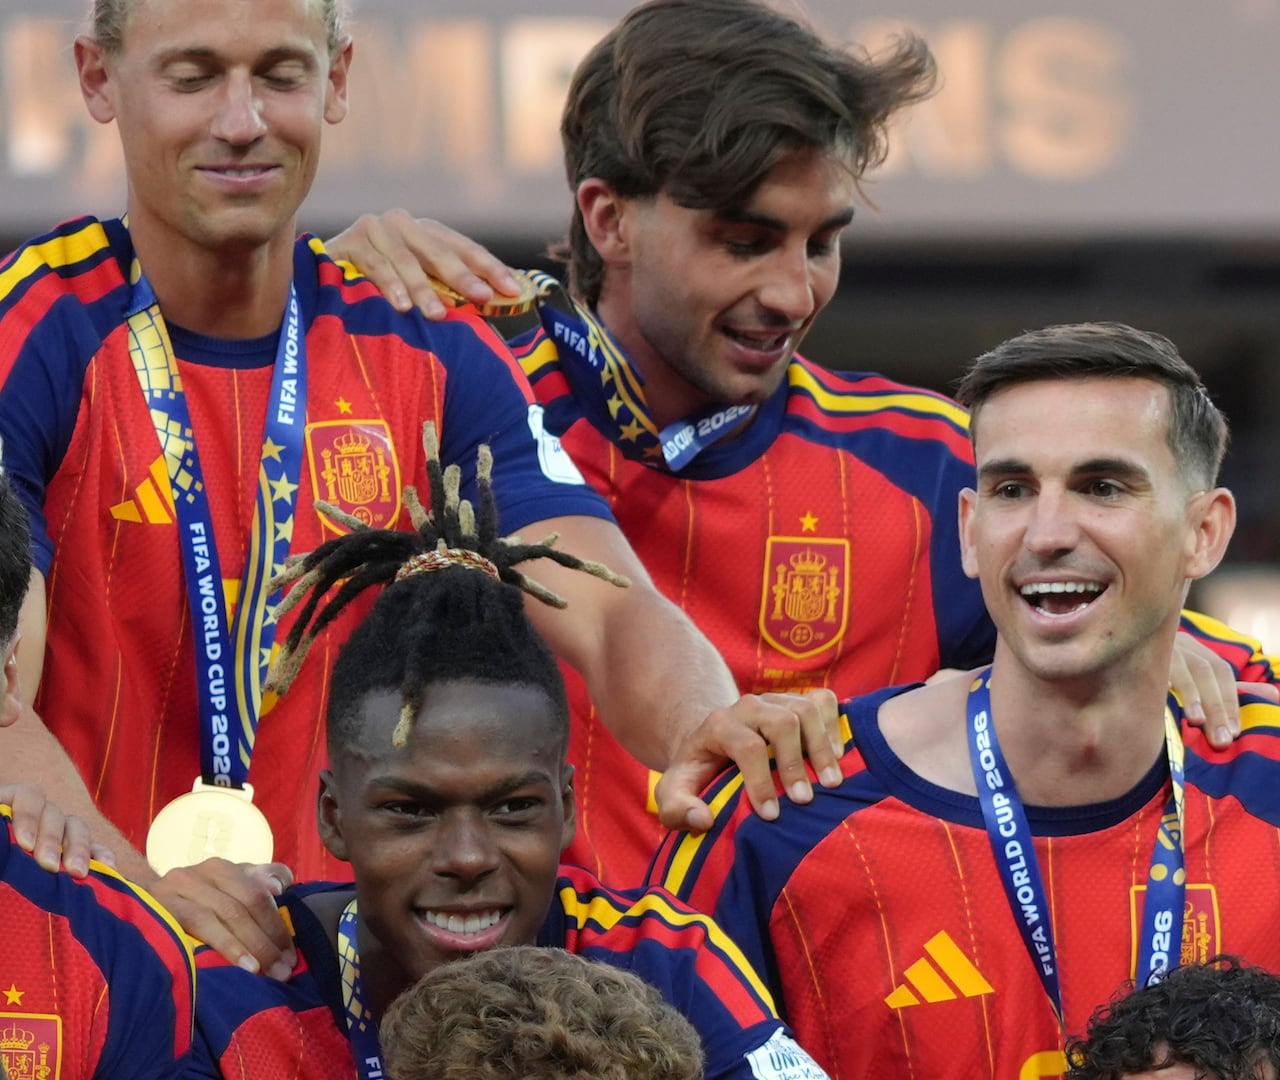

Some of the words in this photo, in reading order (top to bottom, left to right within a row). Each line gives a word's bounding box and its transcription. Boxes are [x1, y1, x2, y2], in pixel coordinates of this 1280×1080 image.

[284, 297, 299, 375] WORLD
[553, 321, 590, 356] FIFA
[277, 378, 297, 425] FIFA
[673, 424, 696, 451] CUP
[189, 522, 211, 573] FIFA
[198, 575, 221, 661] WORLD
[207, 663, 227, 711] CUP
[974, 710, 1004, 790] 2026
[992, 792, 1017, 838] CUP
[1005, 843, 1041, 926] WORLD
[1031, 927, 1054, 977] FIFA
